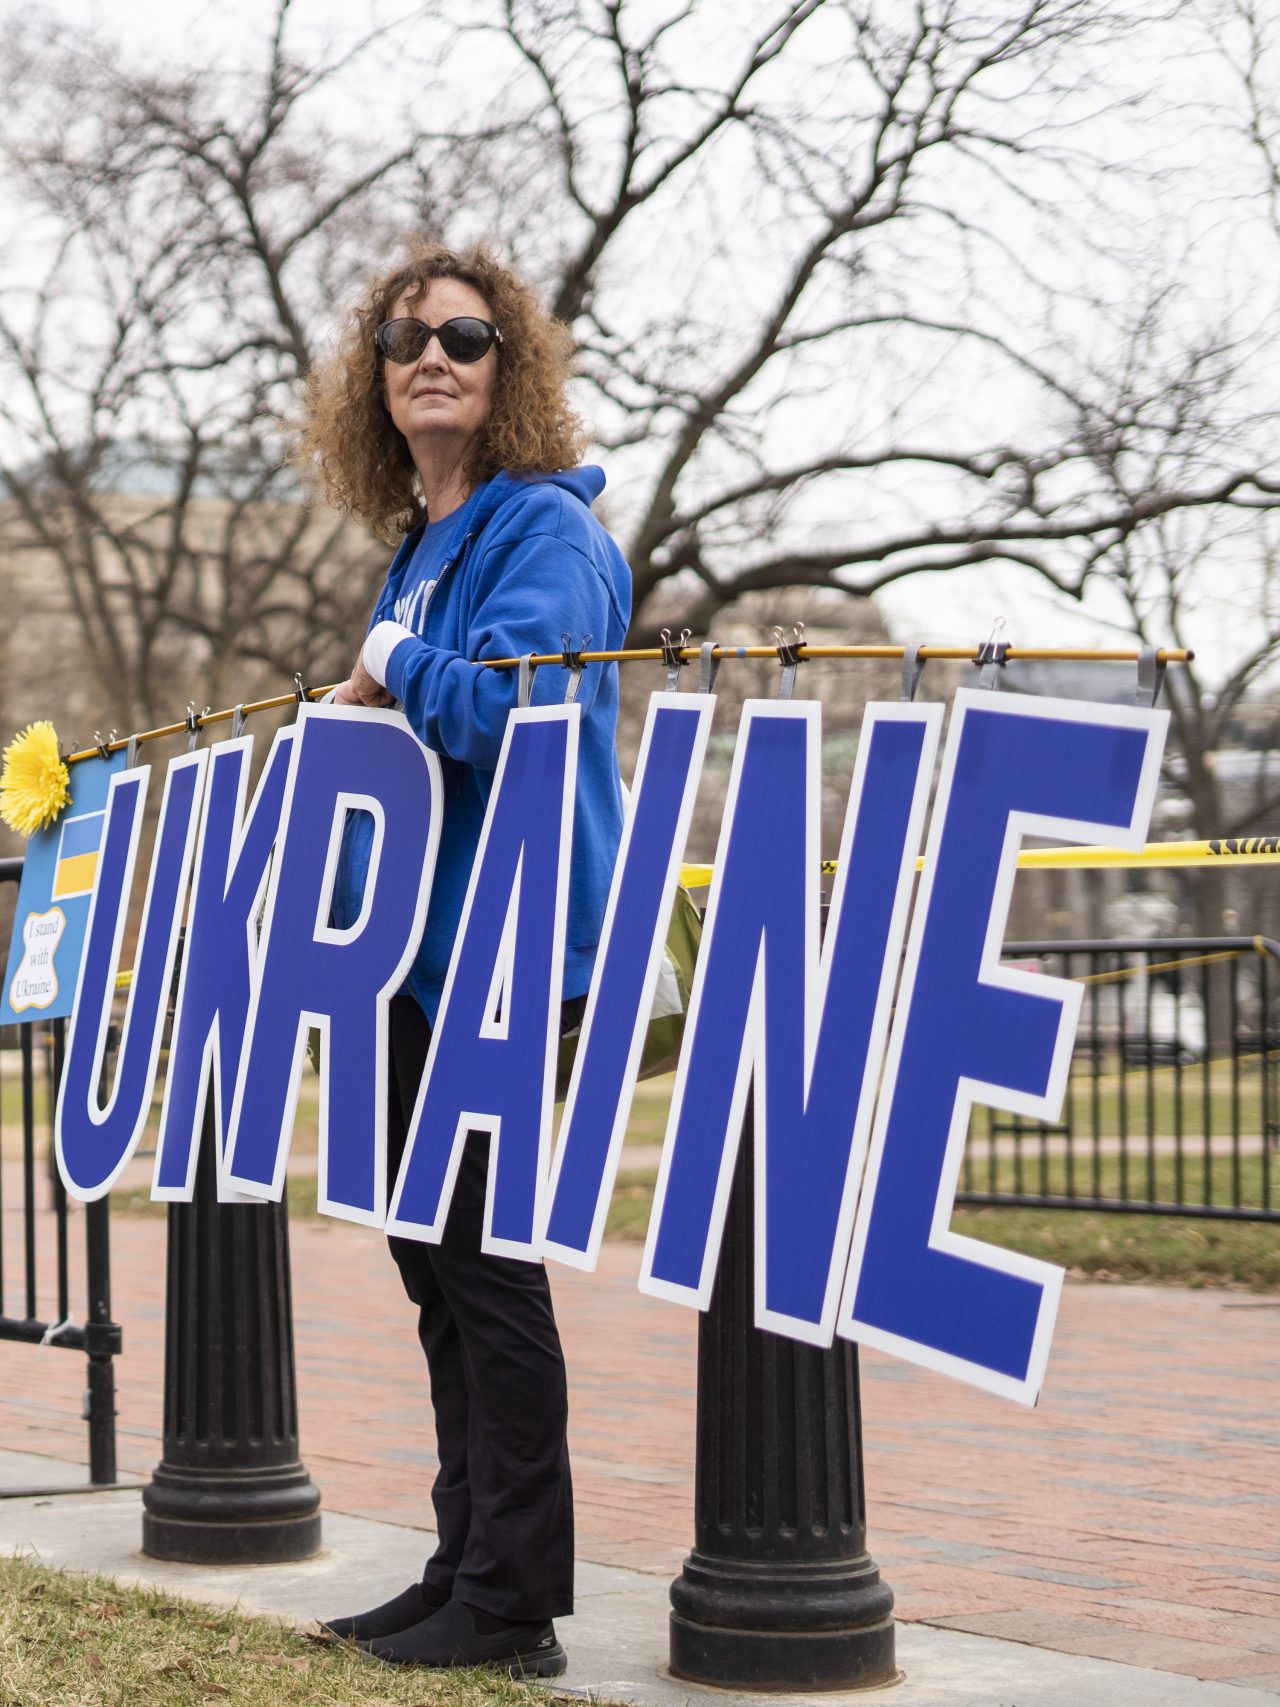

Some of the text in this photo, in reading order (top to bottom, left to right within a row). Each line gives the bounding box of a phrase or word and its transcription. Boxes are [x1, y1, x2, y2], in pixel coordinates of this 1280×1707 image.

[35, 915, 59, 937] stand
[29, 947, 49, 966] with
[55, 687, 1170, 1406] UKRAINE
